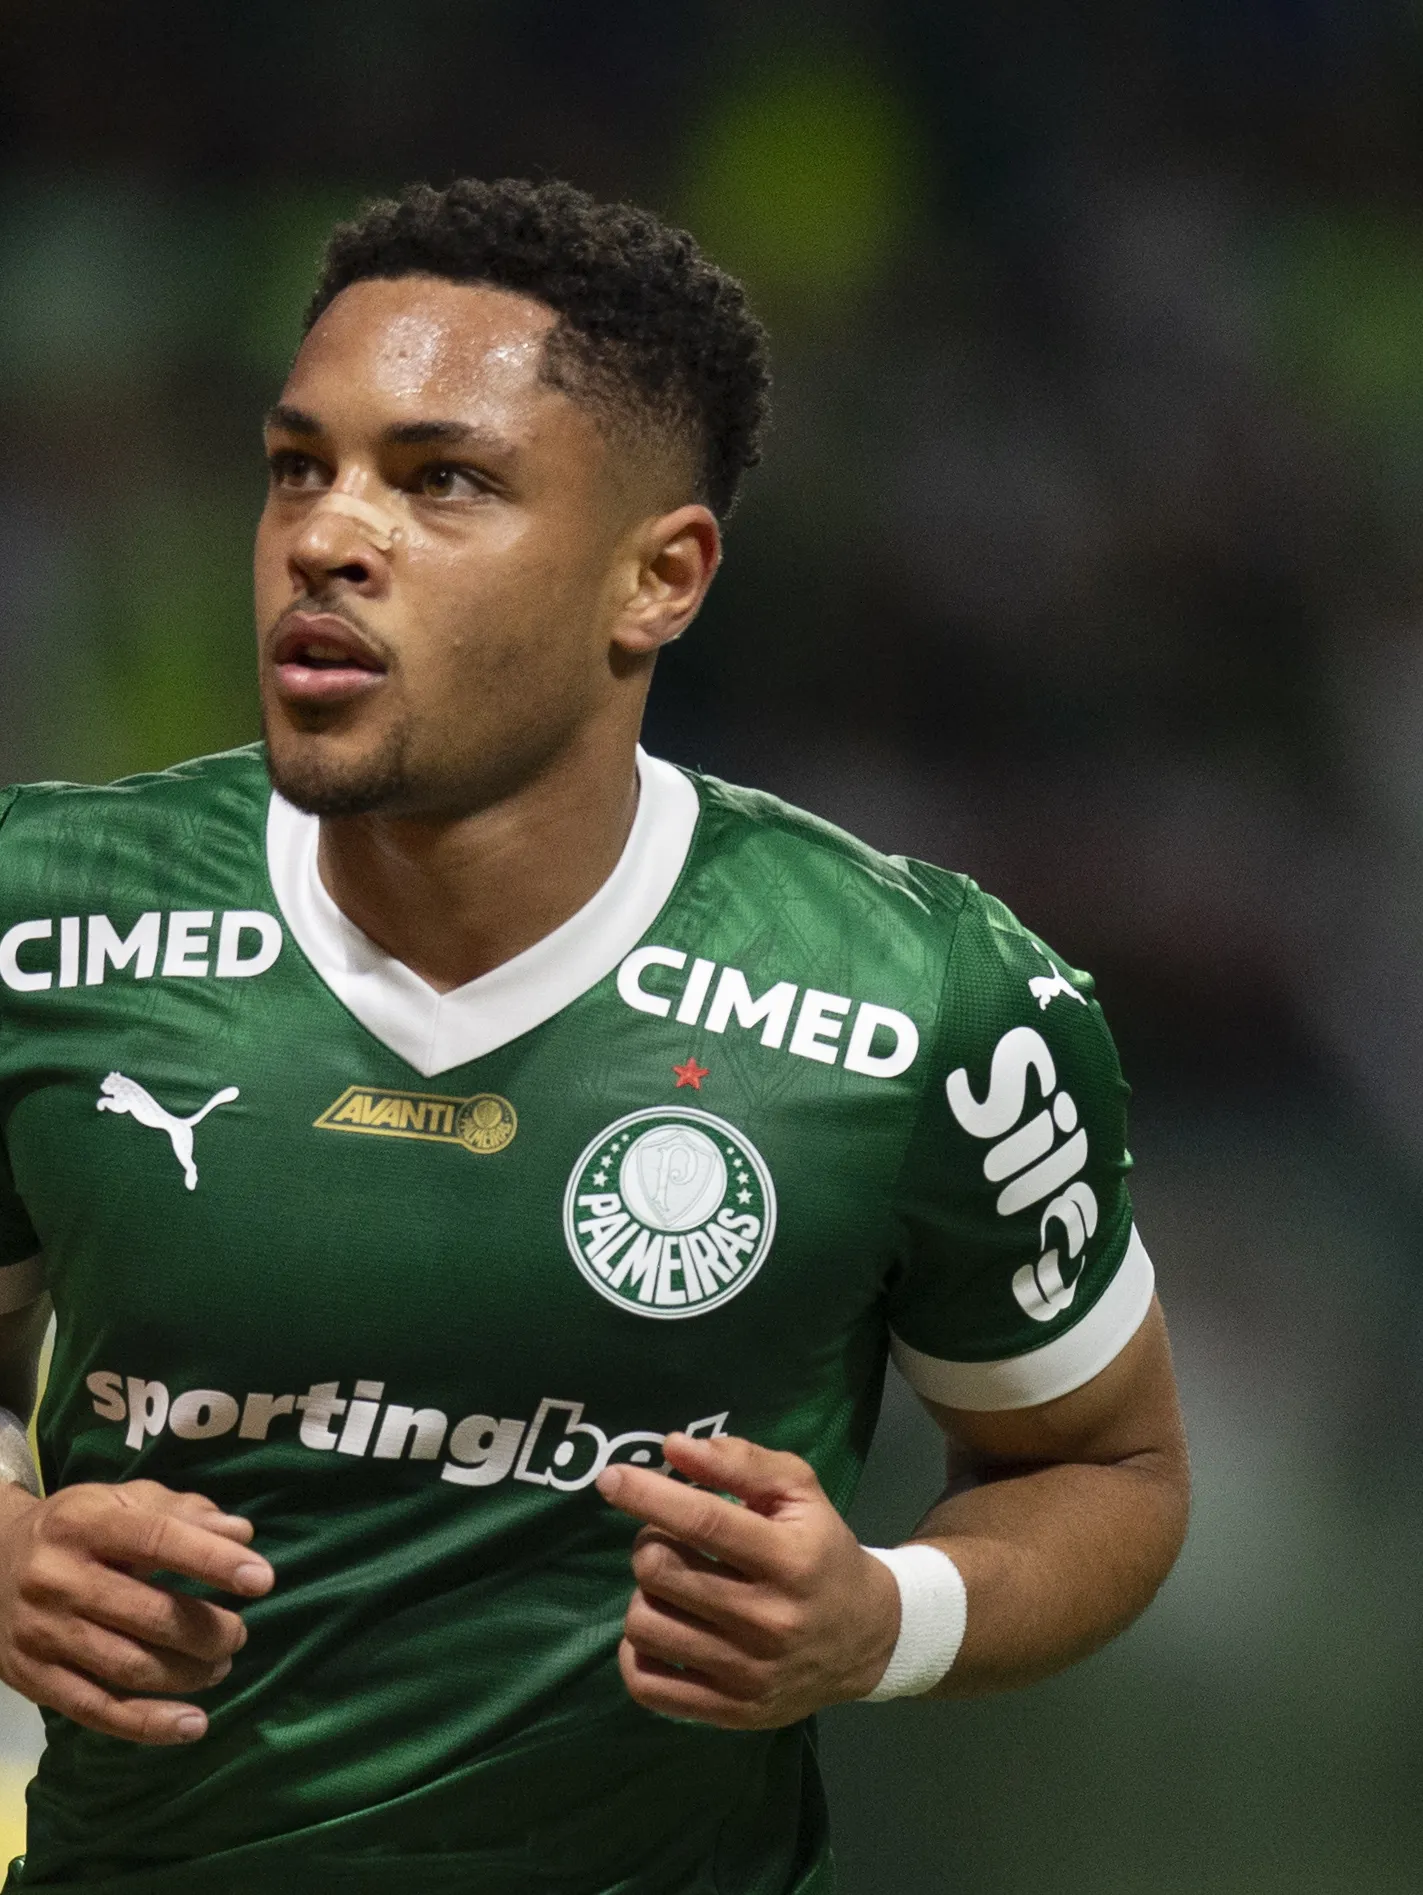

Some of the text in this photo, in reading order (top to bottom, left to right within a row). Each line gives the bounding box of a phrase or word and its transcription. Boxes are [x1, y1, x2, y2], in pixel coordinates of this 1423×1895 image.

[616, 944, 920, 1079] CIMED
[332, 1093, 456, 1134] AVANTI
[577, 1192, 762, 1306] PALMEIRAS
